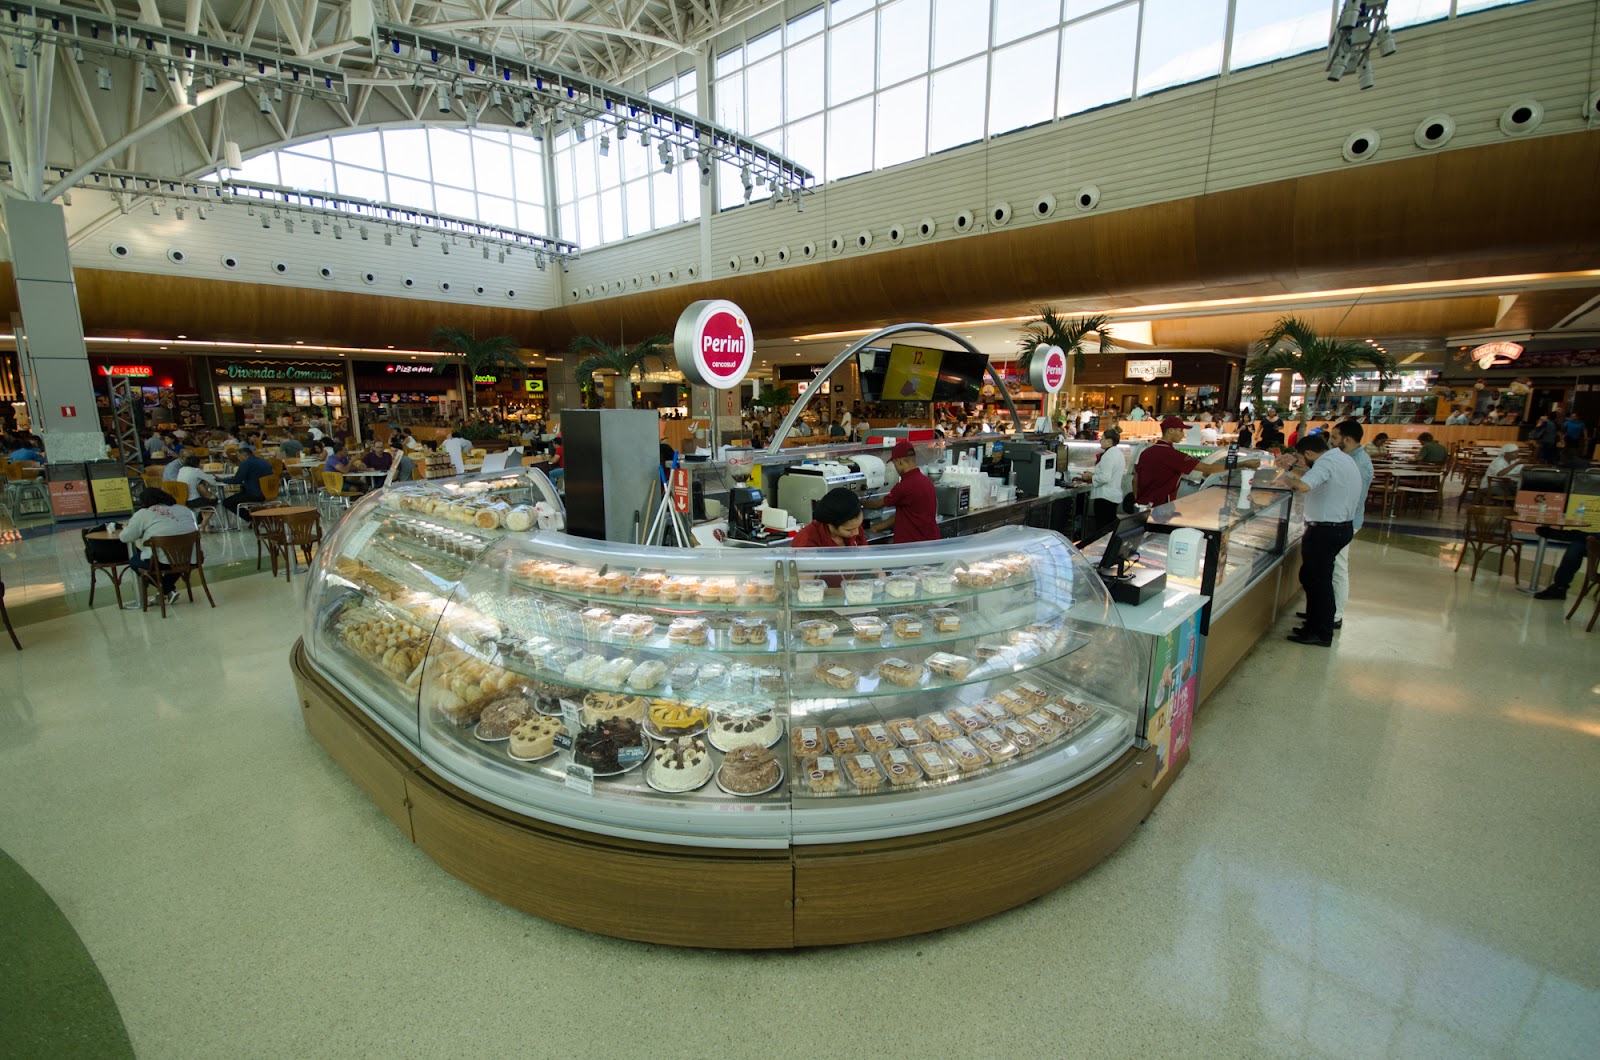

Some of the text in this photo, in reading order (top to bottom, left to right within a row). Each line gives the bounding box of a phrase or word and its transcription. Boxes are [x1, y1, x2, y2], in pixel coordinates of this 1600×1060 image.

[703, 335, 744, 353] Perini
[101, 365, 150, 375] Versatto
[227, 365, 333, 380] Vivenda do Camarão
[395, 365, 434, 374] Pizza Hut
[1046, 365, 1063, 376] Perini
